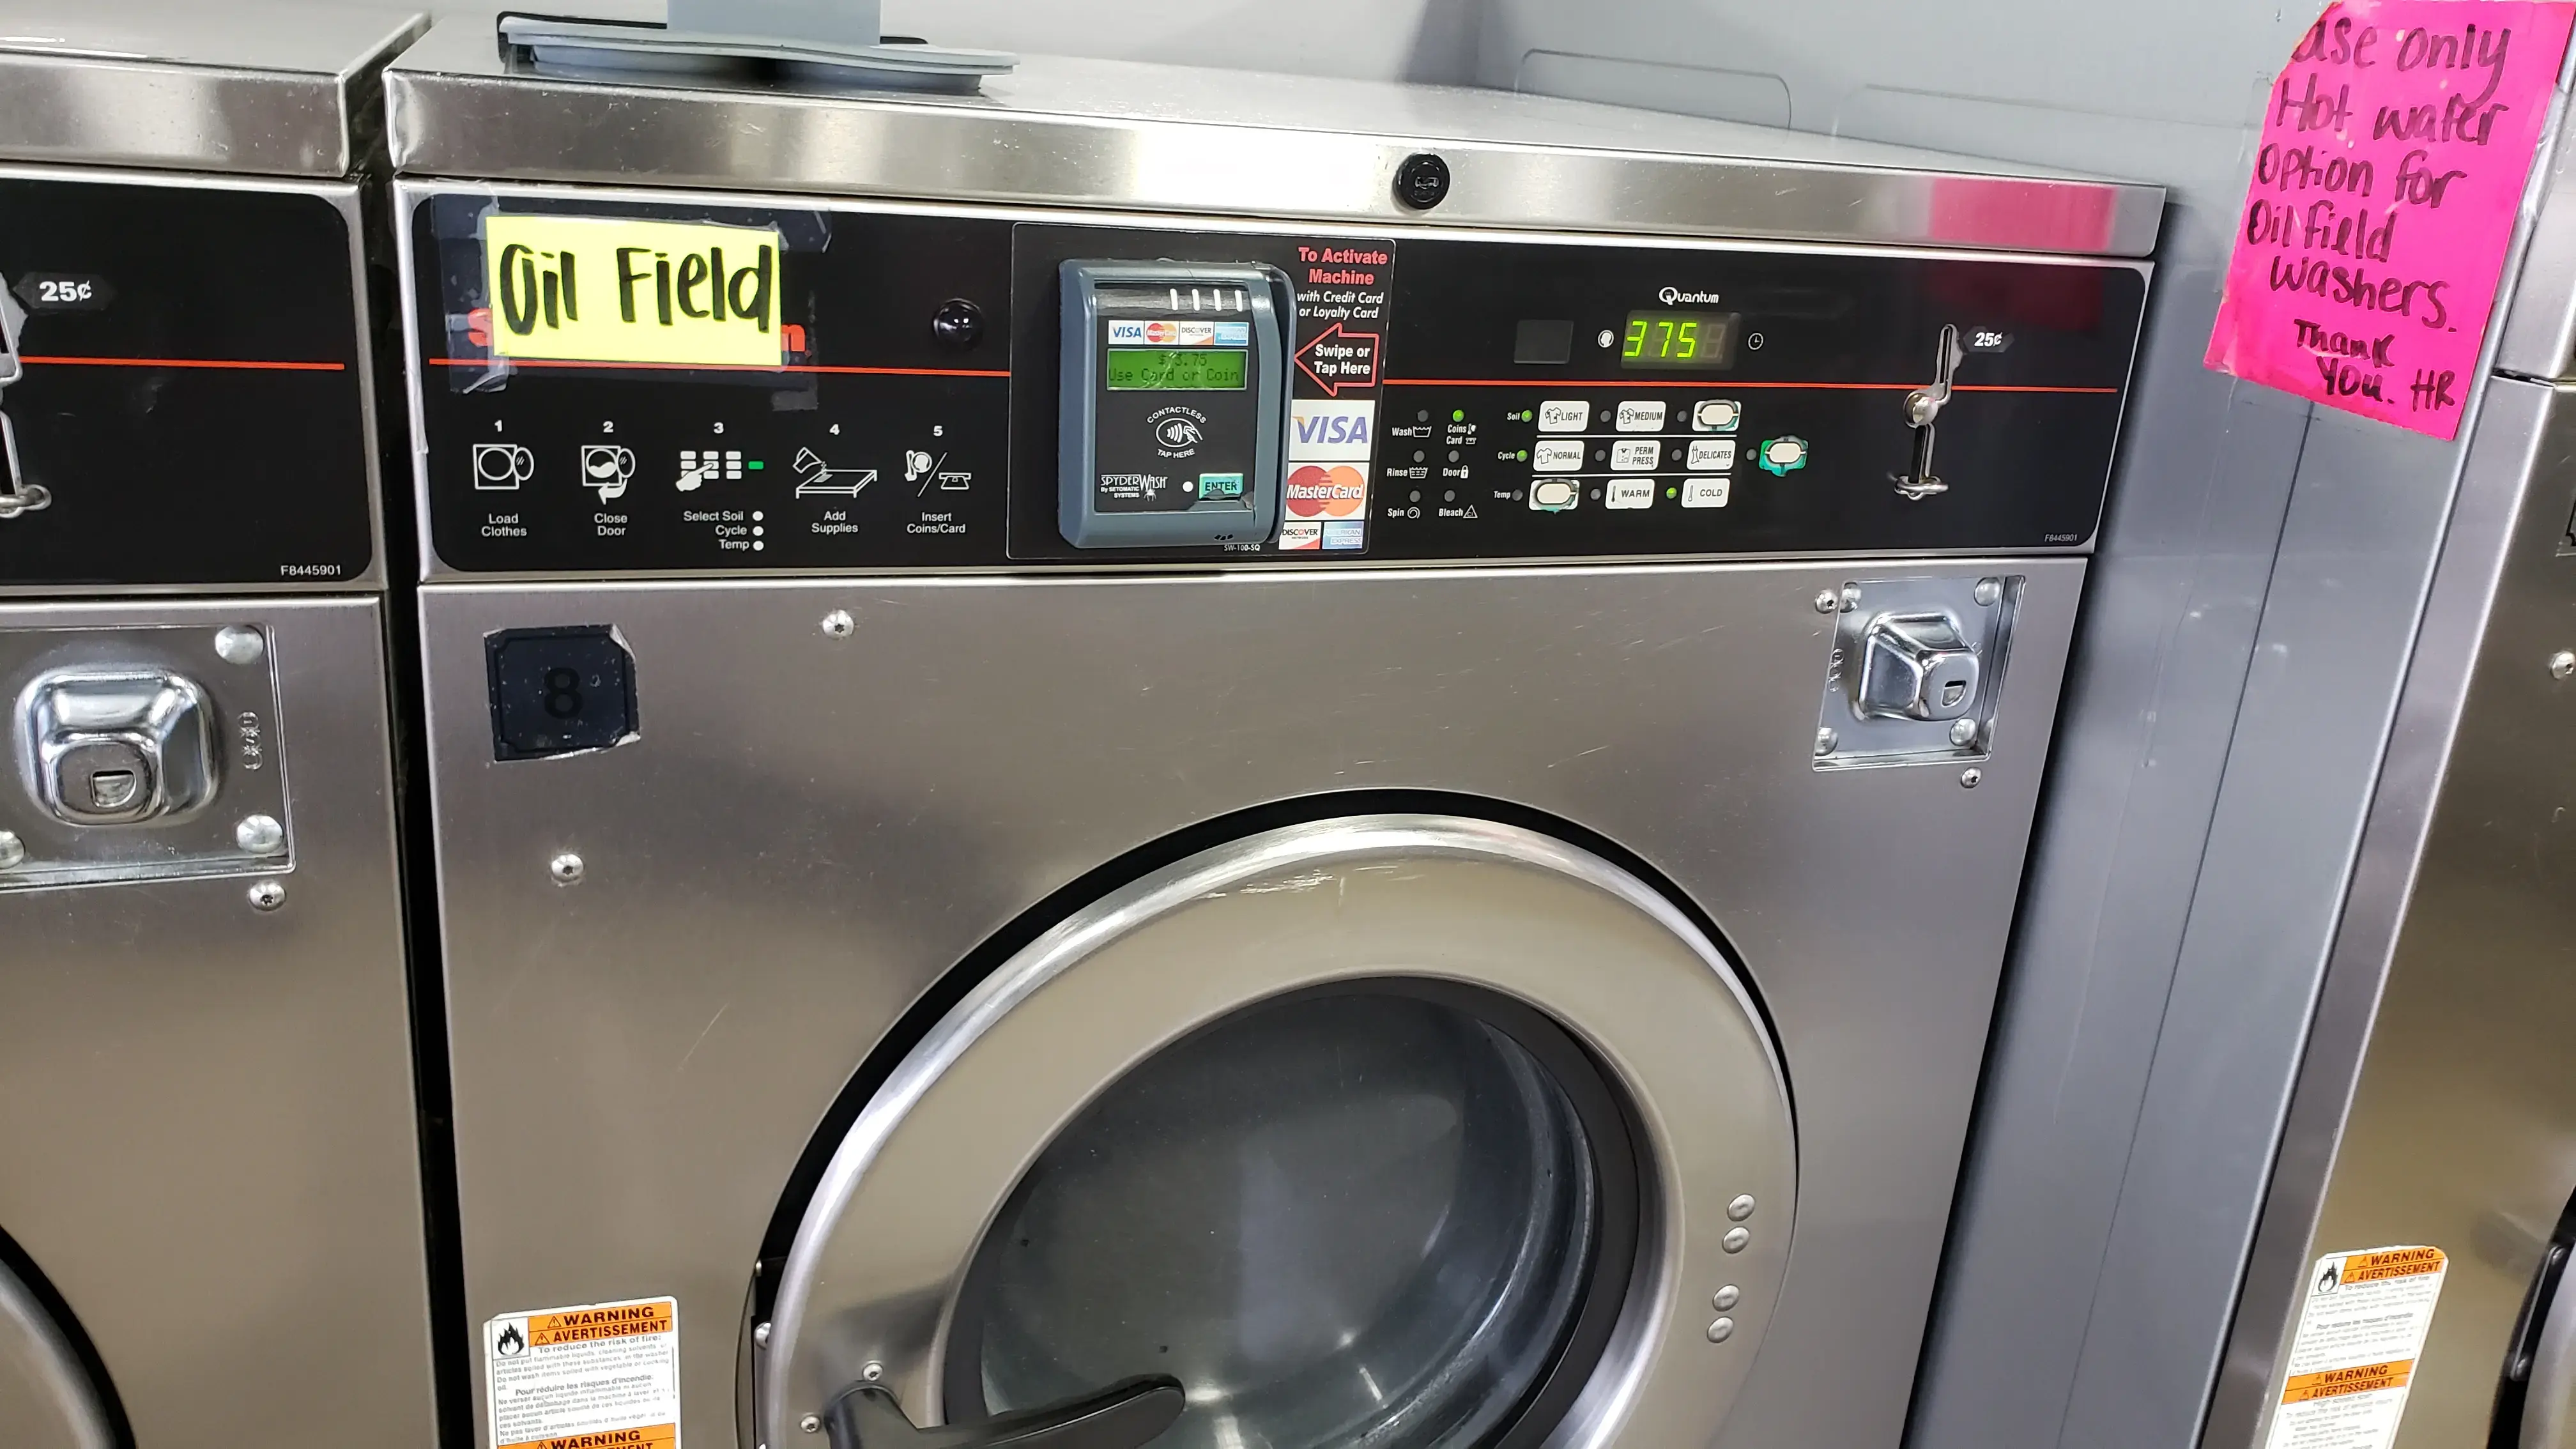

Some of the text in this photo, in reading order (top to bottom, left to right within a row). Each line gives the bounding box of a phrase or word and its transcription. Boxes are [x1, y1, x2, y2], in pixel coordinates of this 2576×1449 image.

[2277, 73, 2510, 145] Hot water
[2395, 150, 2469, 209] for
[1298, 247, 1388, 264] To Activate
[1308, 268, 1374, 285] Machine
[40, 280, 92, 302] 25¢
[500, 243, 578, 335] Oil
[616, 245, 772, 334] Field
[1296, 290, 1384, 304] with Credit Card
[1659, 286, 1719, 305] Quantum
[1299, 305, 1379, 320] or Loyalty Card
[1113, 326, 1142, 338] VISA
[1623, 321, 1697, 359] 375
[1974, 332, 2003, 347] 25¢
[1315, 344, 1370, 360] Swipe or
[1108, 368, 1239, 381] Use Card or Coin
[1314, 361, 1370, 376] Tap Here
[2411, 368, 2456, 411] HR
[1147, 406, 1207, 424] CONTACTLESS
[1561, 411, 1583, 421] LIGHT
[1634, 411, 1663, 421] MEDIUM
[494, 420, 503, 432] 1
[603, 421, 614, 433] 2
[714, 422, 724, 434] 3
[829, 424, 840, 435] 4
[933, 425, 943, 437] 5
[1292, 416, 1368, 443] VISA
[1392, 427, 1413, 436] Wash
[1447, 424, 1467, 433] Coins
[1446, 436, 1462, 445] Card
[1157, 448, 1195, 459] TAP HERE
[1498, 452, 1515, 460] Cycle
[1552, 451, 1581, 460] NORMAL
[1635, 447, 1654, 456] PERM
[1699, 450, 1732, 459] DELICATES
[1632, 456, 1653, 465] PRESS
[1387, 468, 1407, 477] Rinse
[1443, 468, 1460, 477] Door
[1204, 481, 1238, 491] ENTER
[1286, 484, 1364, 500] MasterCard
[1494, 491, 1511, 500] Temp
[1621, 489, 1650, 498] WARM
[1699, 489, 1722, 497] COLD
[489, 513, 519, 525] Load
[594, 513, 627, 525] Close
[683, 511, 744, 522] Select Soil
[824, 511, 847, 522] Add
[921, 512, 952, 522] Insert
[1388, 509, 1404, 518] Spin
[1438, 509, 1464, 517] Bleach
[481, 526, 527, 537] Clothes
[597, 525, 626, 536] Door
[715, 525, 747, 537] Cycle
[811, 523, 859, 535] Supplies
[906, 523, 966, 535] Coins/Card
[2044, 533, 2078, 542] F8445901
[719, 539, 750, 551] Temp
[280, 564, 341, 576] F8445901
[544, 668, 583, 719] 8
[2371, 1248, 2435, 1266] WARNING
[2358, 1261, 2441, 1281] AVERTISSEMENT
[564, 1307, 654, 1326] WARNING
[553, 1319, 667, 1343] AVERTISSEMENT
[553, 1342, 587, 1353] reduce
[642, 1334, 661, 1342] fire:
[2324, 1365, 2388, 1384] WARNING
[516, 1388, 535, 1396] Pour
[580, 1379, 610, 1388] risques
[2312, 1377, 2394, 1399] AVERTISSEMENT
[551, 1430, 641, 1449] WARNING
